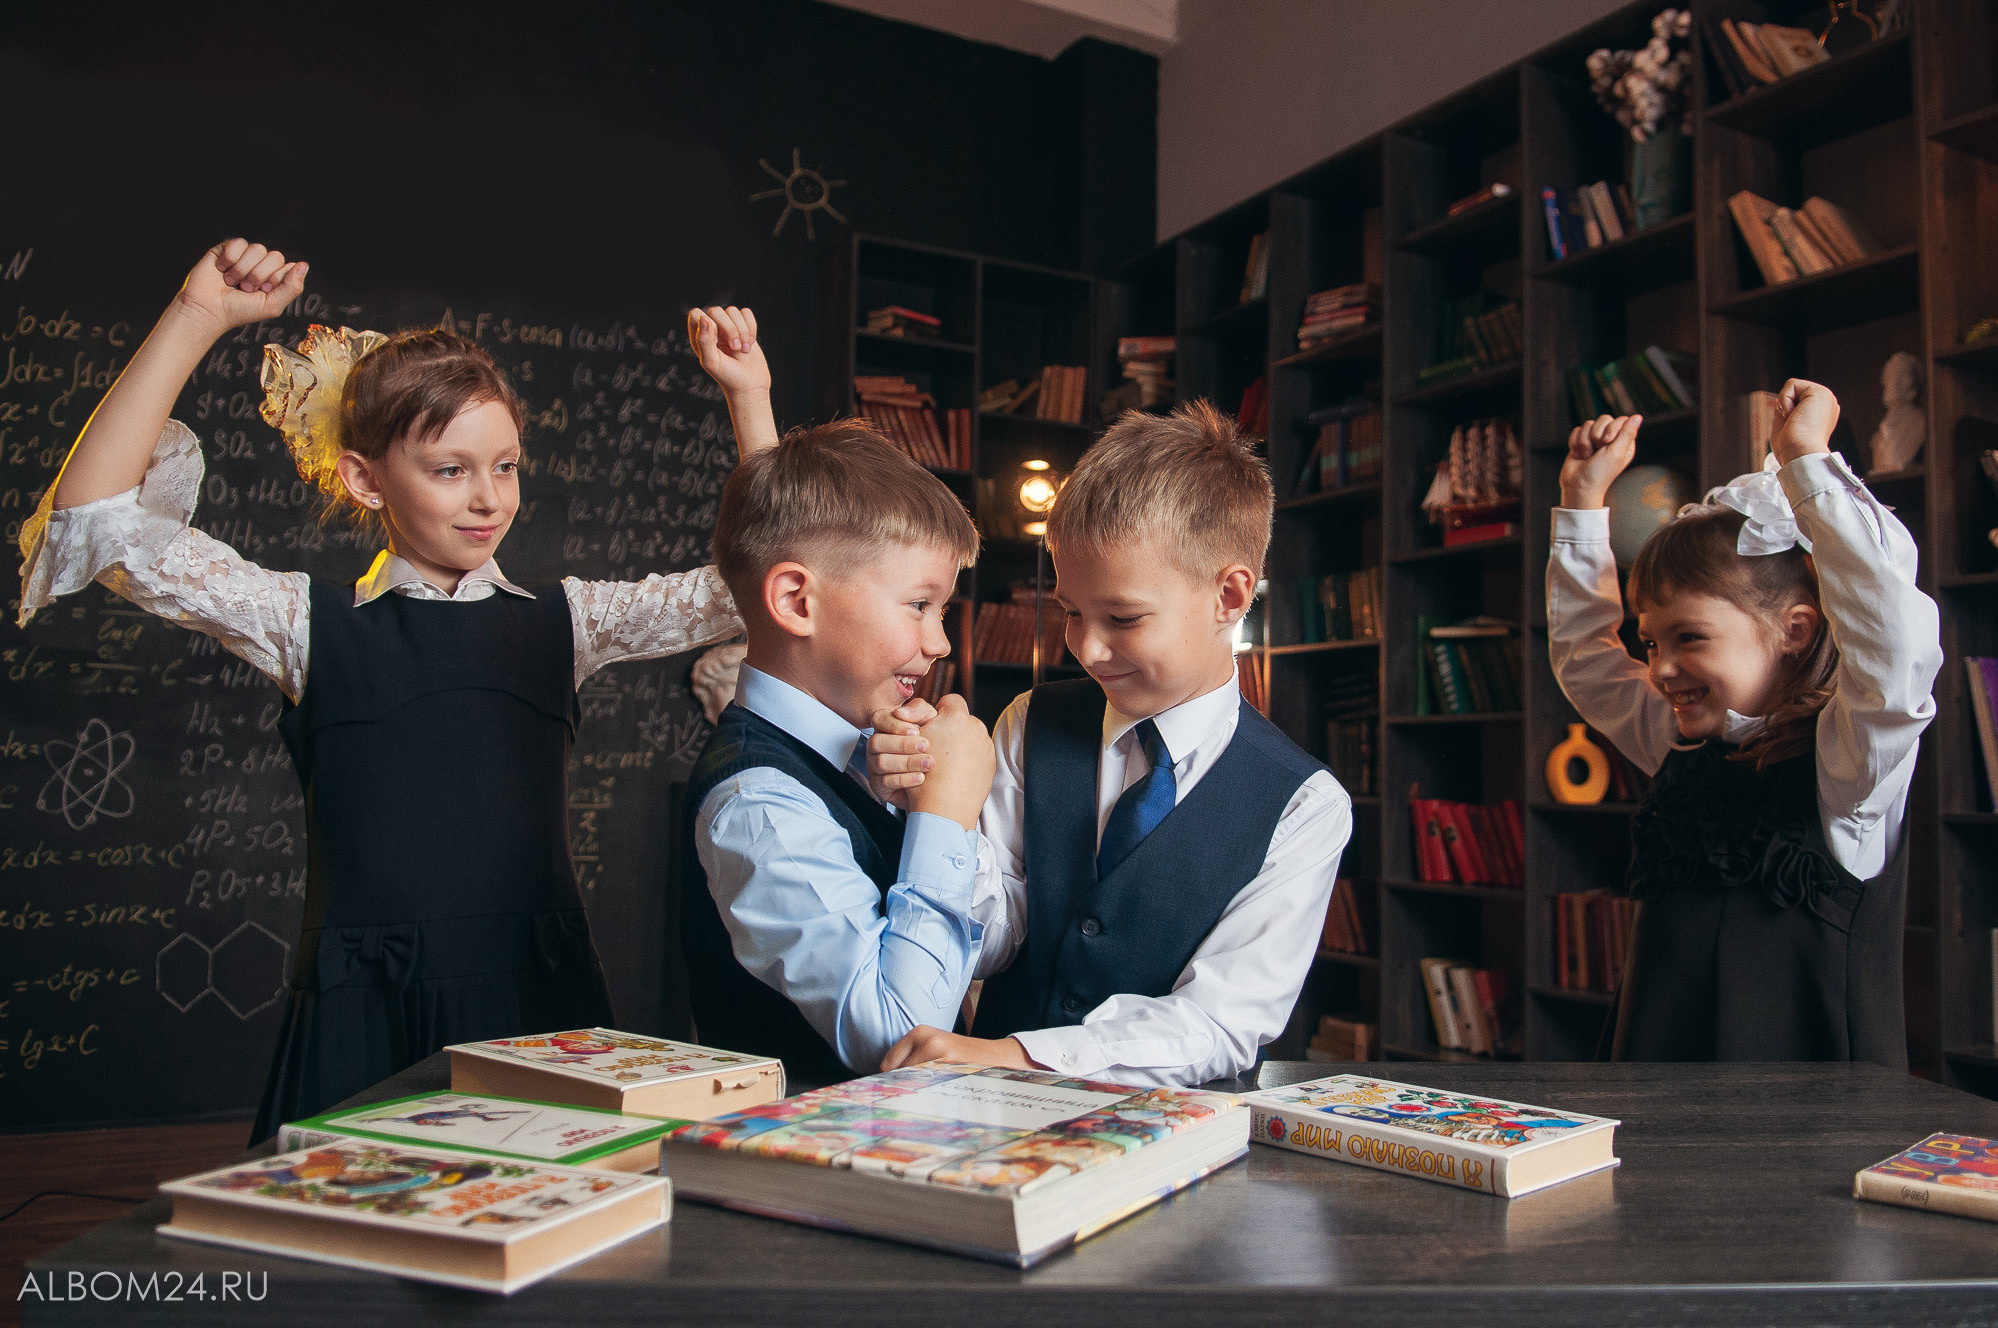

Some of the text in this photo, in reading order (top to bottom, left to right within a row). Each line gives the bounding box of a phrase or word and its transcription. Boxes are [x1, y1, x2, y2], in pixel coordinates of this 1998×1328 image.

[1289, 1121, 1483, 1188] Я ПОЗНАЮ МИР
